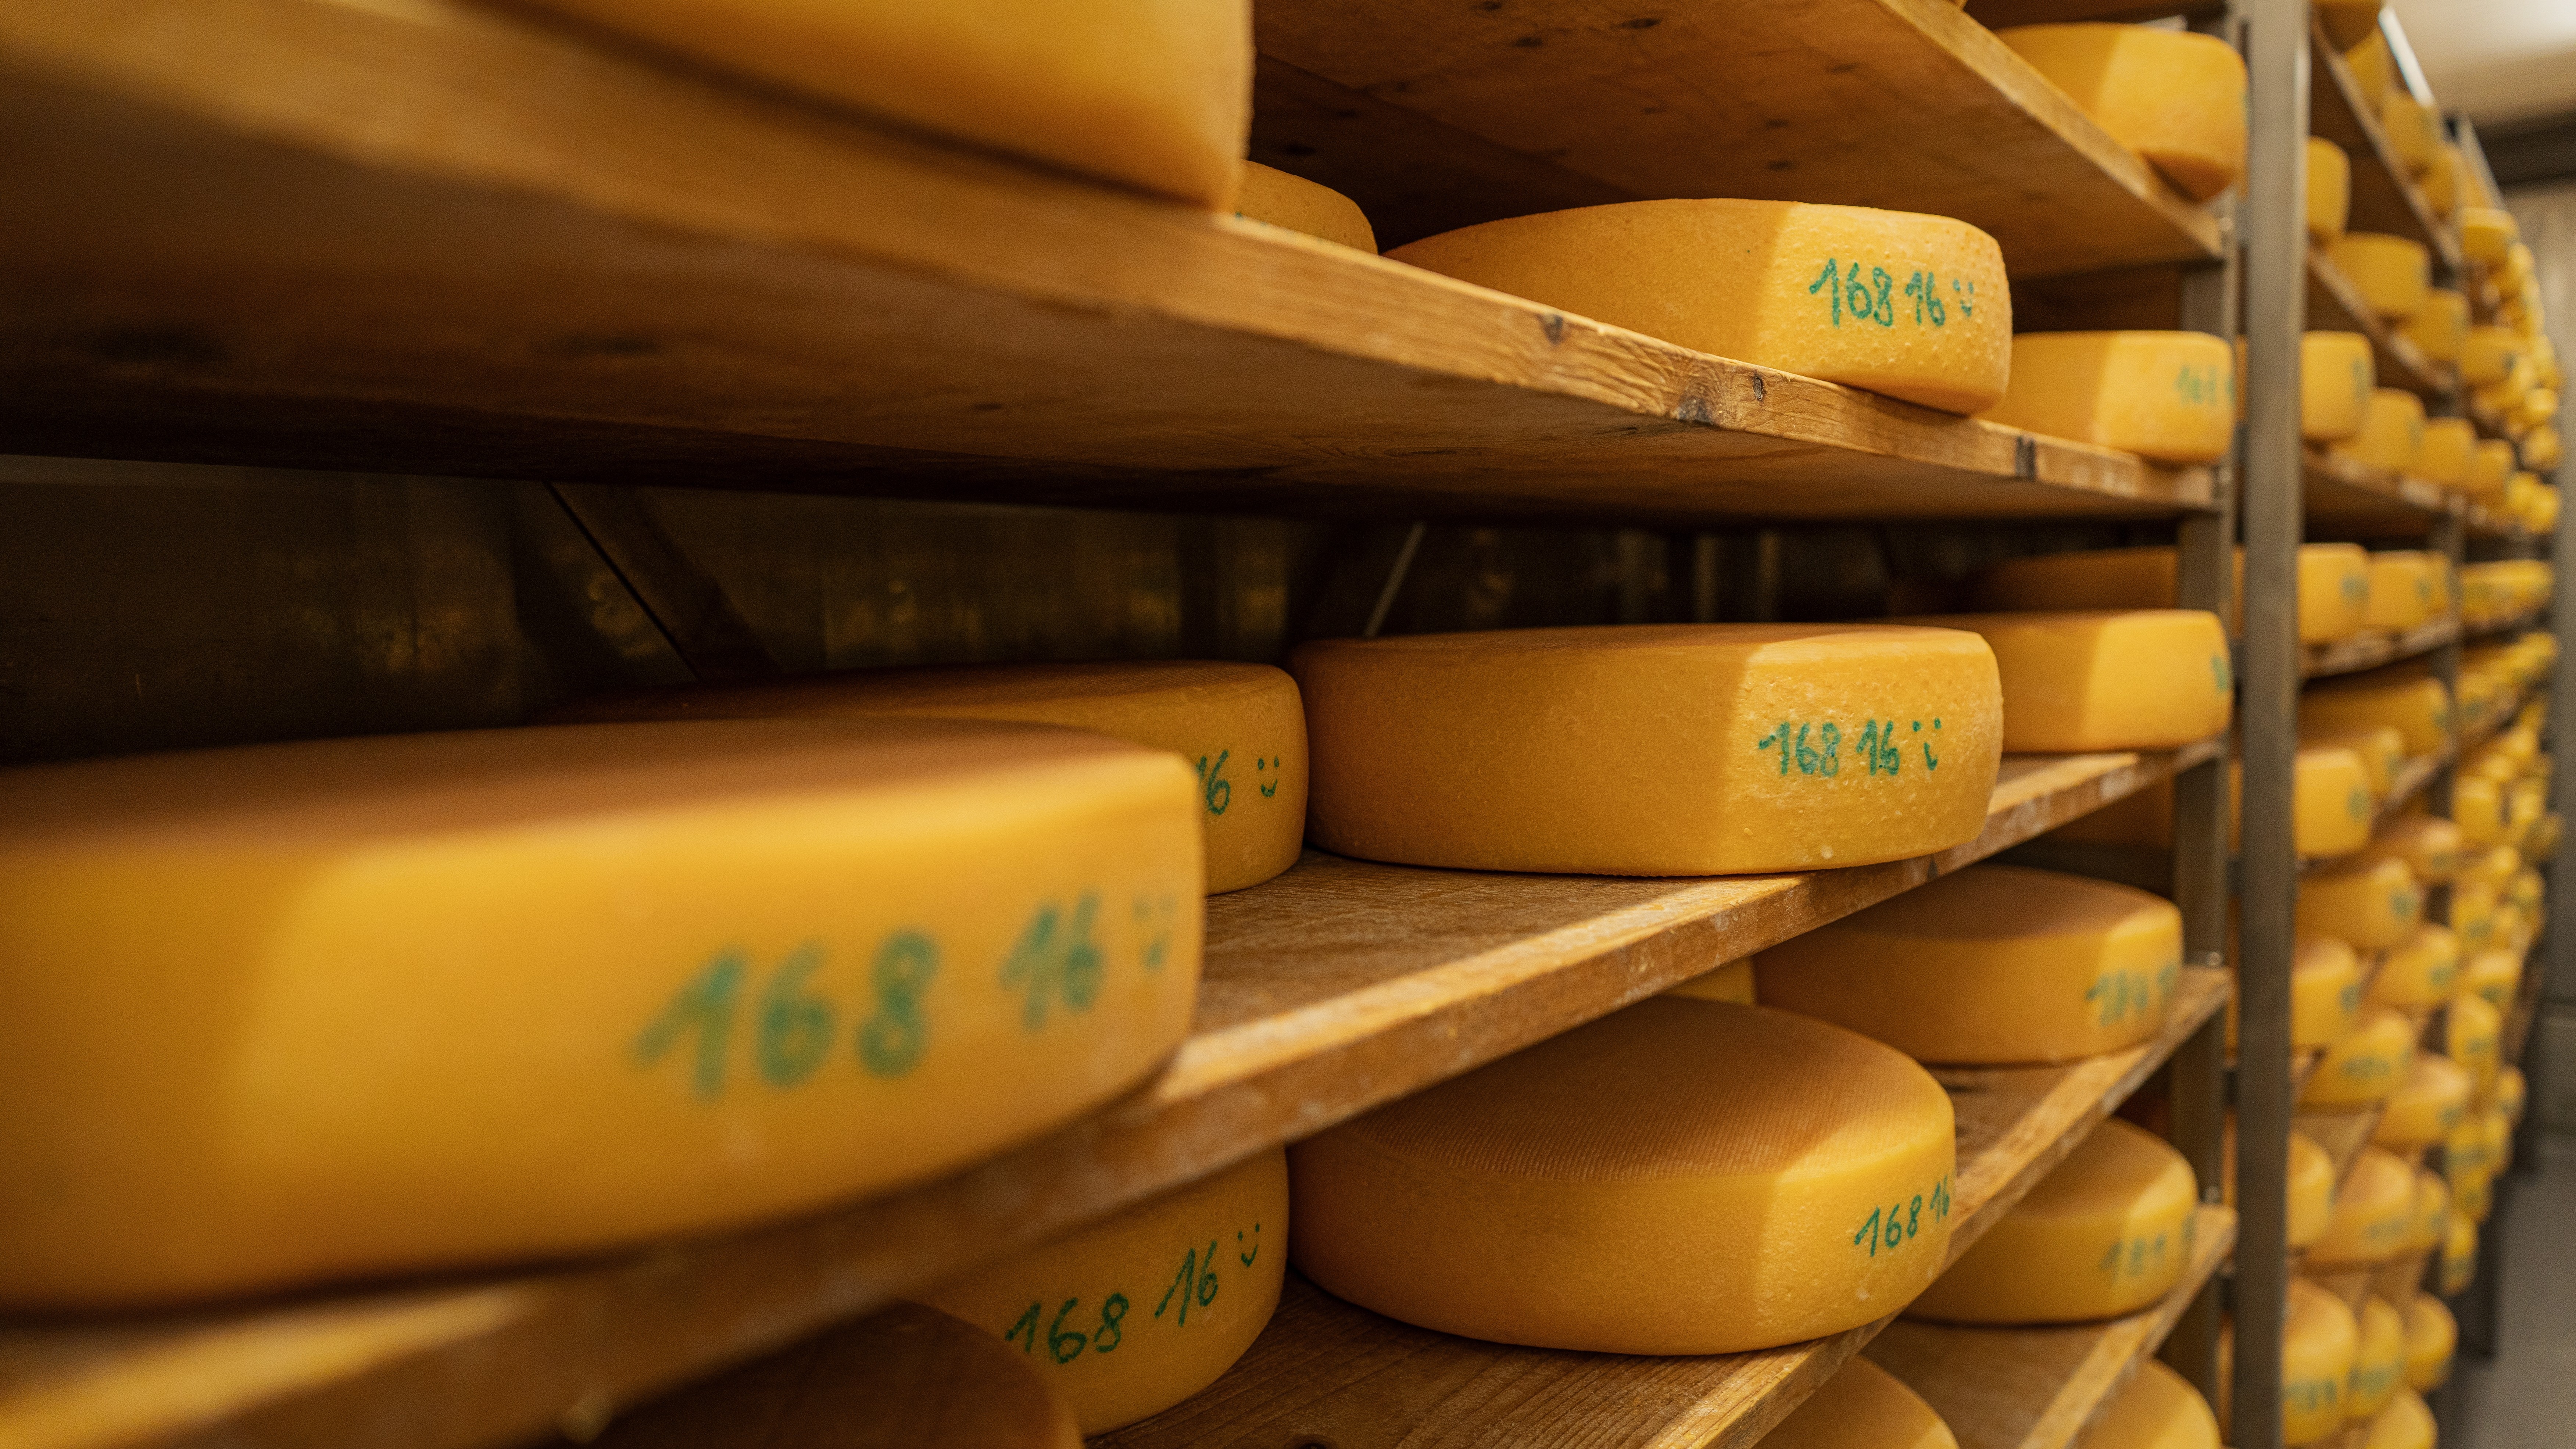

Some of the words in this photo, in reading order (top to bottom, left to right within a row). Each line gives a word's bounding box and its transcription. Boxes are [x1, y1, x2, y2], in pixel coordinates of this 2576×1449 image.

[1808, 257, 1893, 328] 168
[1904, 271, 1946, 327] 16
[1758, 721, 1842, 777] 168
[1855, 719, 1900, 776] 16
[627, 928, 939, 1100] 168
[997, 888, 1103, 1031] 16
[1854, 1194, 1922, 1257] 168
[1929, 1174, 1950, 1223] 16
[1005, 1292, 1130, 1365] 168
[1153, 1240, 1219, 1327] 16
